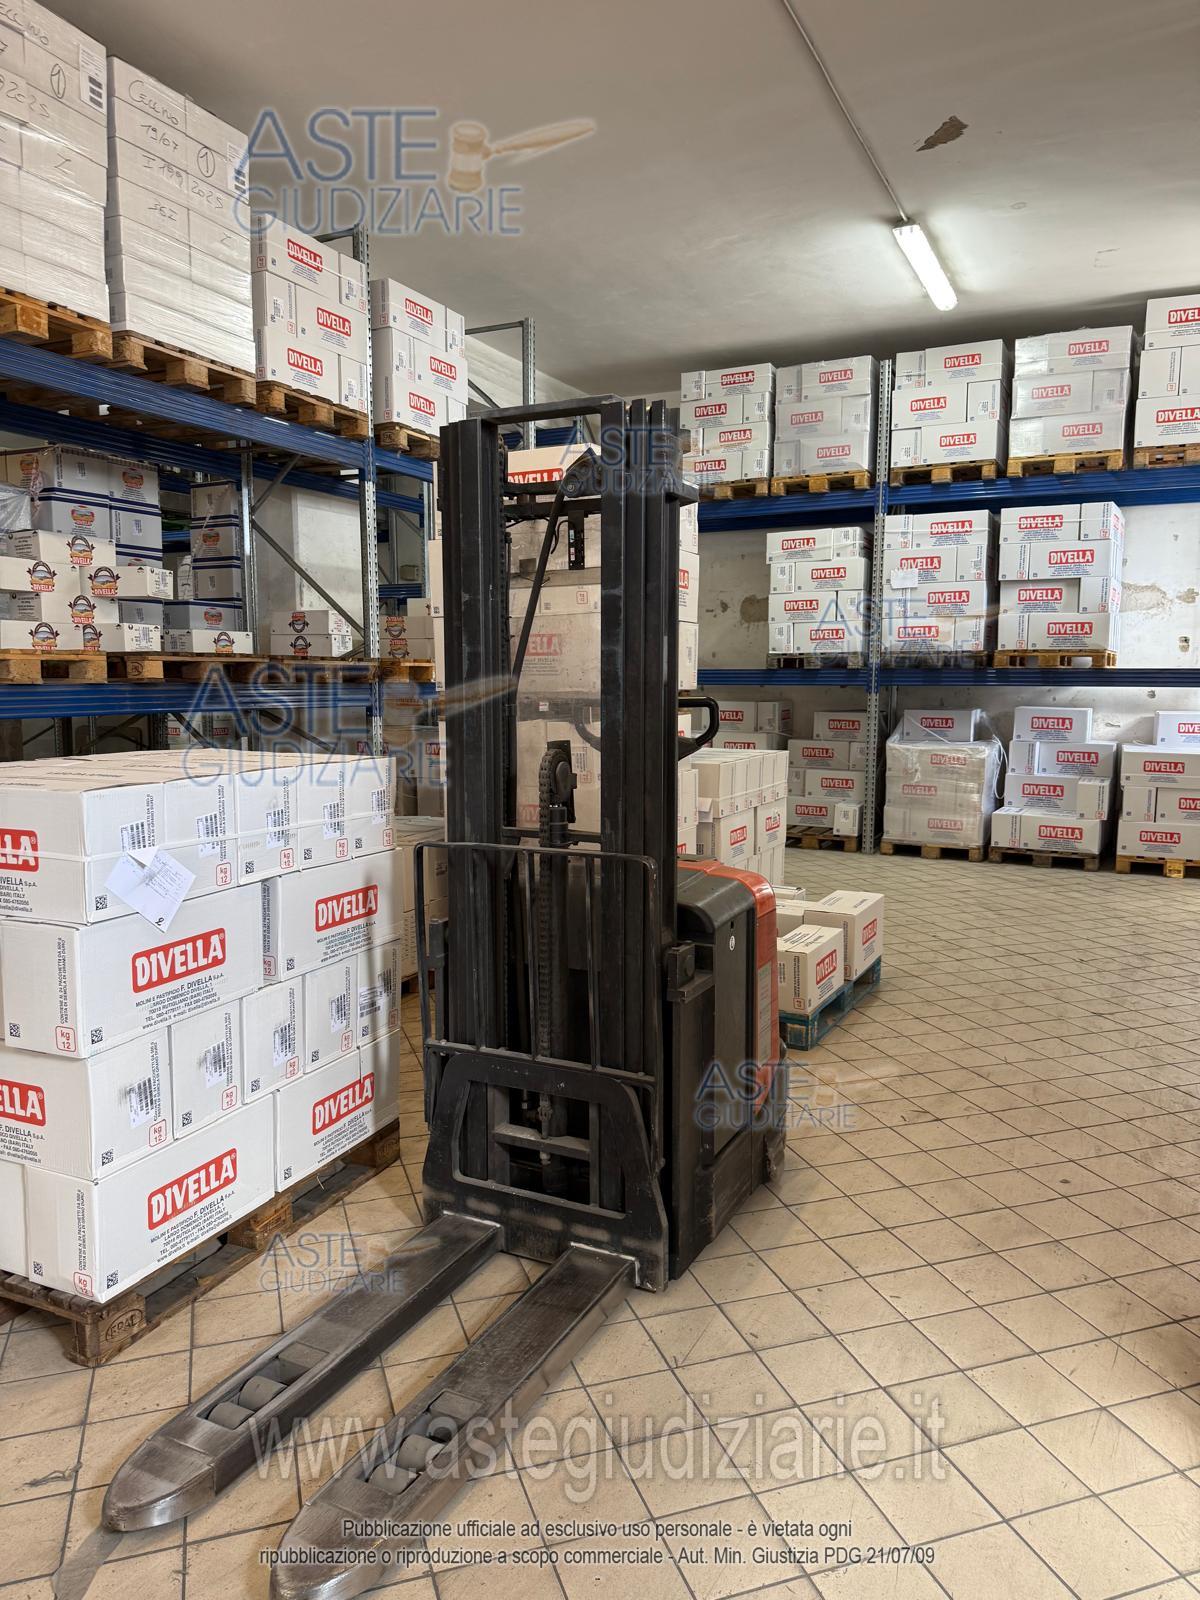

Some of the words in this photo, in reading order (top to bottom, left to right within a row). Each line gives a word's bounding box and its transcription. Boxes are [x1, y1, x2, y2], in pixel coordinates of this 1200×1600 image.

[288, 241, 321, 270] DIVELLA
[406, 300, 432, 323] DIVELLA
[318, 310, 350, 334] DIVELLA
[1069, 342, 1108, 354] DIVELLA
[288, 350, 322, 374] DIVELLA
[945, 355, 980, 368] DIVELLA
[431, 358, 455, 378] DIVELLA
[721, 372, 753, 385] DIVELLA
[820, 370, 852, 382] DIVELLA
[1033, 386, 1070, 398] DIVELLA
[410, 394, 434, 414] DIVELLA
[911, 398, 945, 410] DIVELLA
[696, 405, 726, 417] DIVELLA
[792, 412, 822, 424] DIVELLA
[720, 430, 751, 442] DIVELLA
[1063, 424, 1101, 436] DIVELLA
[941, 434, 975, 446] DIVELLA
[818, 446, 849, 458] DIVELLA
[695, 460, 725, 472] DIVELLA
[931, 521, 971, 535] DIVELLA
[1020, 516, 1062, 529] DIVELLA
[782, 539, 815, 549] DIVELLA
[72, 556, 91, 565] DIVELLA
[901, 557, 939, 569] DIVELLA
[1050, 551, 1093, 564] DIVELLA
[812, 568, 845, 579] DIVELLA
[33, 584, 53, 592] DIVELLA
[94, 588, 116, 596] DIVELLA
[929, 592, 969, 604] DIVELLA
[1019, 589, 1061, 601] DIVELLA
[785, 600, 817, 610] DIVELLA
[74, 616, 92, 624] DIVELLA
[811, 629, 843, 640] DIVELLA
[899, 627, 938, 638] DIVELLA
[1048, 623, 1092, 635] DIVELLA
[720, 711, 743, 720] VELLA
[829, 720, 859, 729] DIVELLA
[921, 718, 953, 728] DIVELLA
[1033, 718, 1071, 729] DIVELLA
[803, 749, 833, 757] DIVELLA
[1058, 752, 1097, 762] DIVELLA
[931, 755, 967, 765] DIVELLA
[1145, 762, 1184, 773] DIVELLA
[822, 779, 853, 789] DIVELLA
[903, 786, 936, 795] DIVELLA
[1023, 785, 1063, 796] DIVELLA
[796, 806, 826, 815] DIVELLA
[929, 819, 962, 830] DIVELLA
[1040, 827, 1081, 839] DIVELLA
[1141, 832, 1180, 843] DIVELLA
[284, 852, 291, 860] kg
[220, 867, 227, 875] kg
[221, 875, 228, 883] 12
[317, 889, 376, 928] DIVELLA
[135, 933, 223, 988] DIVELLA
[816, 952, 836, 983] DIVELLA
[186, 974, 212, 989] DIVELLA
[60, 1030, 70, 1040] kg
[62, 1041, 71, 1049] 12
[314, 1077, 374, 1130] DIVELLA
[5, 1125, 32, 1138] DIVELLA
[153, 1127, 162, 1136] kg
[154, 1135, 162, 1143] 12
[150, 1154, 234, 1224] DIVELLA
[199, 1194, 224, 1215] DIVELLA
